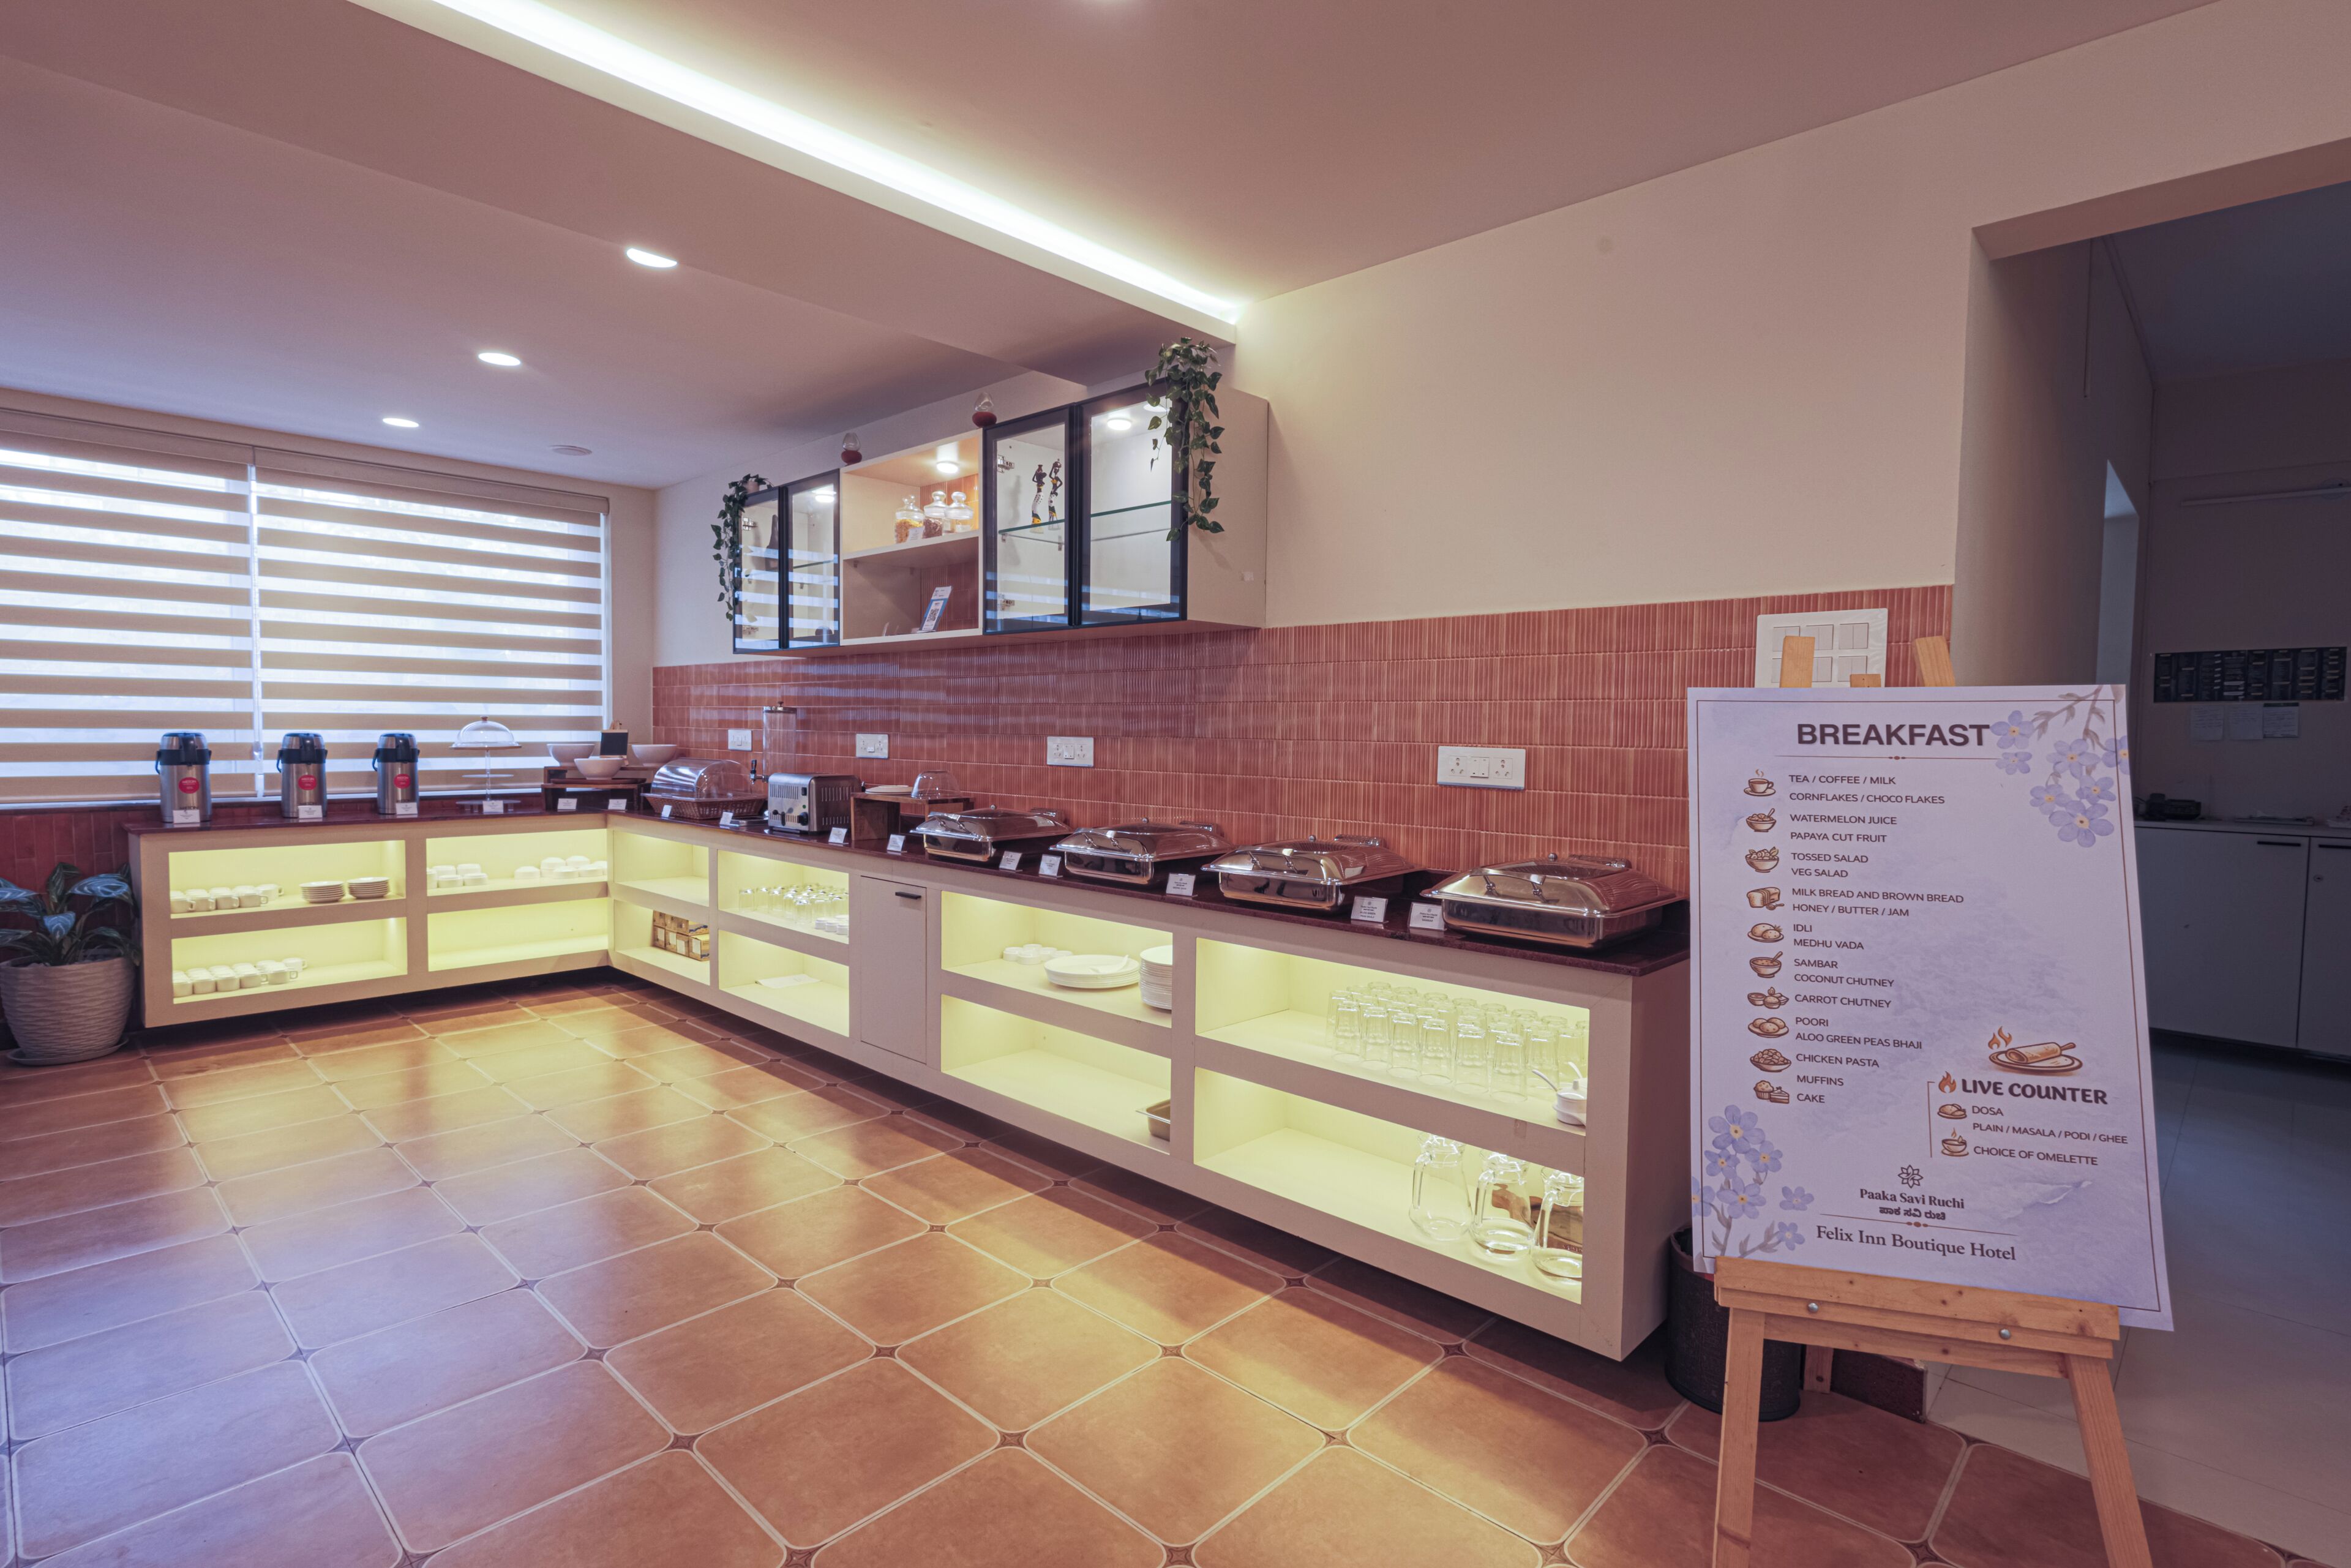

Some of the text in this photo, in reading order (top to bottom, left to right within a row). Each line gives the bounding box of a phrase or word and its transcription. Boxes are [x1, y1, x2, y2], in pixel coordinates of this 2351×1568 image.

[1798, 724, 1990, 746] BREAKFAST
[1790, 793, 1858, 801] CORNFLAKES
[1790, 814, 1865, 823] WATERMELON
[1791, 832, 1829, 841] PAPAYA
[1834, 854, 1868, 863] SALAD
[1815, 869, 1848, 877] SALAD
[1882, 892, 1924, 901] BROWN
[1927, 894, 1963, 902] BREAD
[1793, 904, 1829, 912] HONEY
[1838, 906, 1878, 915] BUTTER
[1794, 939, 1864, 950] MEDHU VADA
[1794, 959, 1838, 969] SAMBAR
[1794, 974, 1894, 987] COCONUT CHUTNEY
[1795, 994, 1891, 1008] CARROT CHUTNEY
[1796, 1017, 1828, 1026] POORI
[1796, 1033, 1922, 1049] ALOO GREEN PEAS BHAJI
[1796, 1054, 1879, 1068] CHICKEN PASTA
[1797, 1075, 1843, 1086] MUFFINS
[1962, 1079, 2107, 1105] LIVE COUNTER
[1797, 1093, 1825, 1103] CAKE
[1972, 1106, 2003, 1116] DOSA
[1973, 1123, 2003, 1132] PLAIN
[2012, 1127, 2056, 1137] MASALA
[2064, 1131, 2090, 1140] PODI
[2099, 1134, 2128, 1144] GHEE
[1974, 1146, 2015, 1157] CHOICE
[2037, 1152, 2098, 1165] OMELETTE
[1860, 1189, 1964, 1209] Paaka Savi Ruchi
[1817, 1226, 2015, 1260] Felix Inn Boutique Hotel
